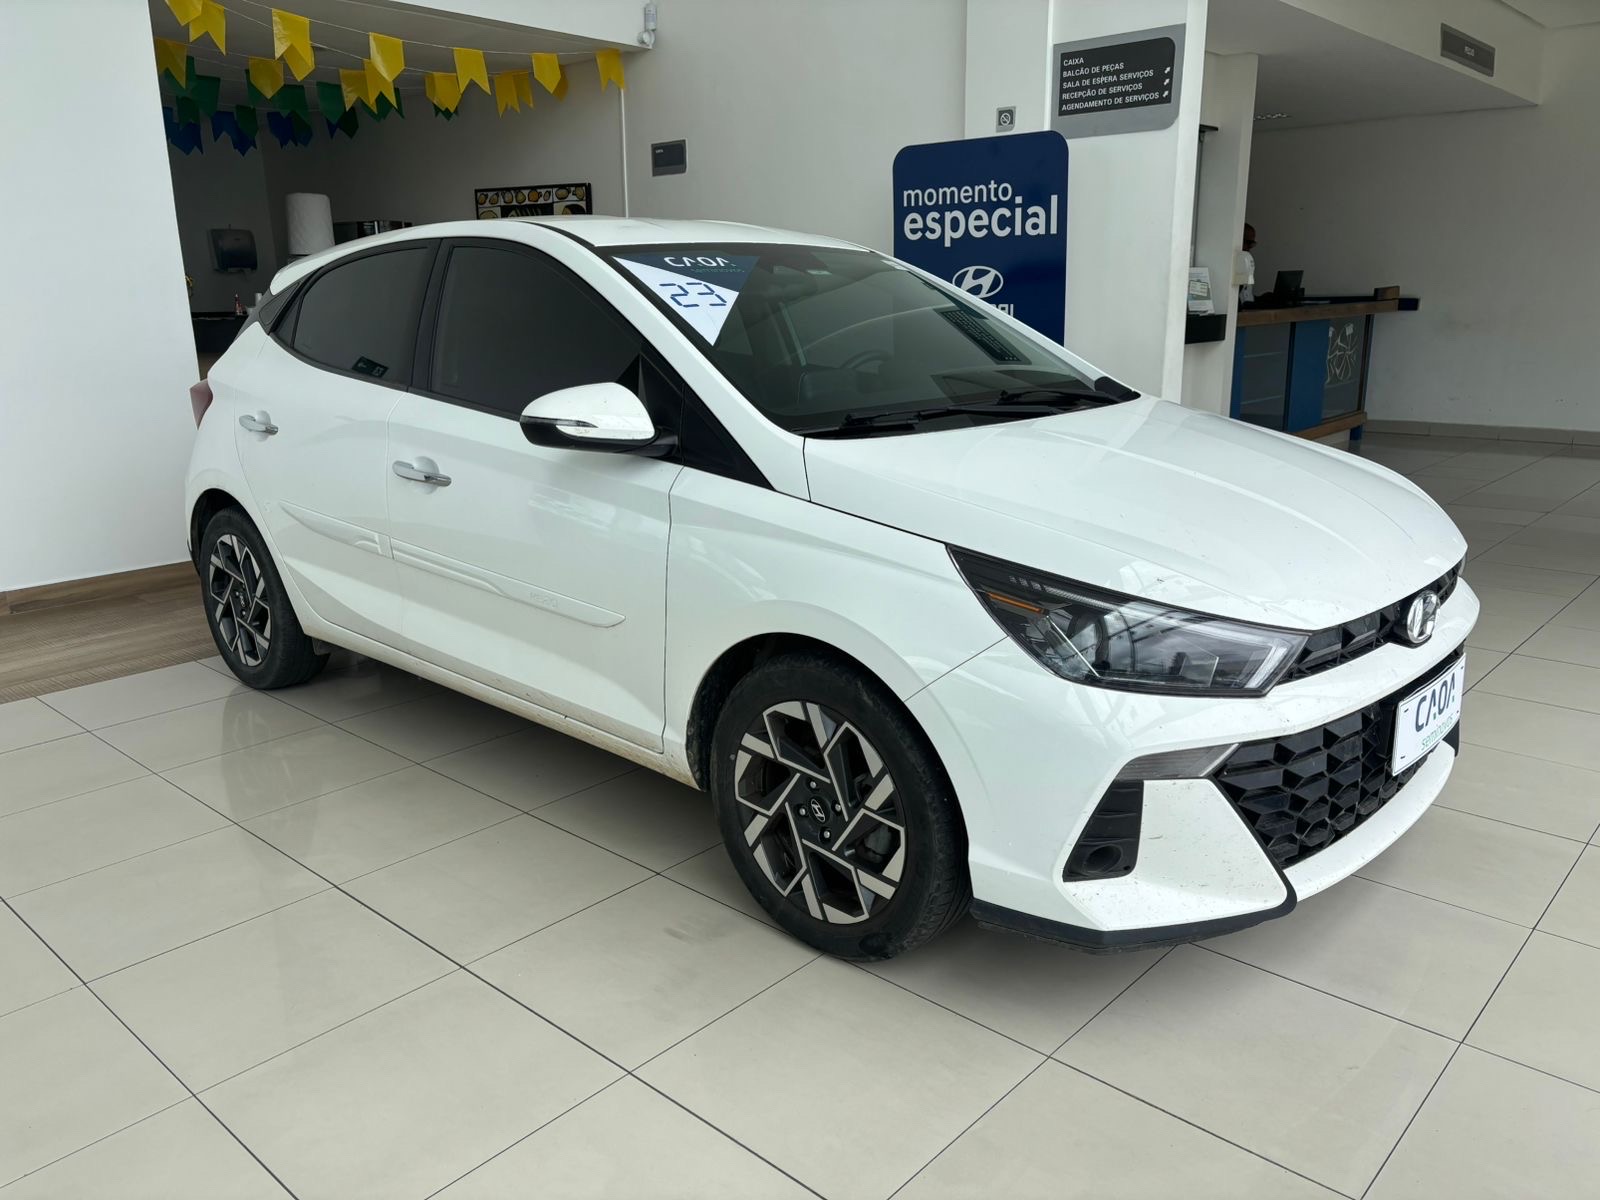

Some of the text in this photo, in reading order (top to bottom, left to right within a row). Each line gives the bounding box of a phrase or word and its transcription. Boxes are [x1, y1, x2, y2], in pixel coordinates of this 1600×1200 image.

[1062, 62, 1125, 78] BALCÃO DE PEÇAS
[1063, 57, 1084, 67] CAIXA
[1062, 69, 1154, 89] SALA DE ESPERA SERVIÇOS
[1061, 91, 1160, 111] AGENDAMENTO DE SERVIÇOS
[1062, 82, 1143, 100] RECEPÇÃO DE SERVIÇOS
[903, 180, 1013, 207] momento
[903, 194, 1058, 248] especial
[663, 256, 737, 267] CAOA
[659, 281, 728, 308] 23
[1415, 672, 1455, 733] CAOA
